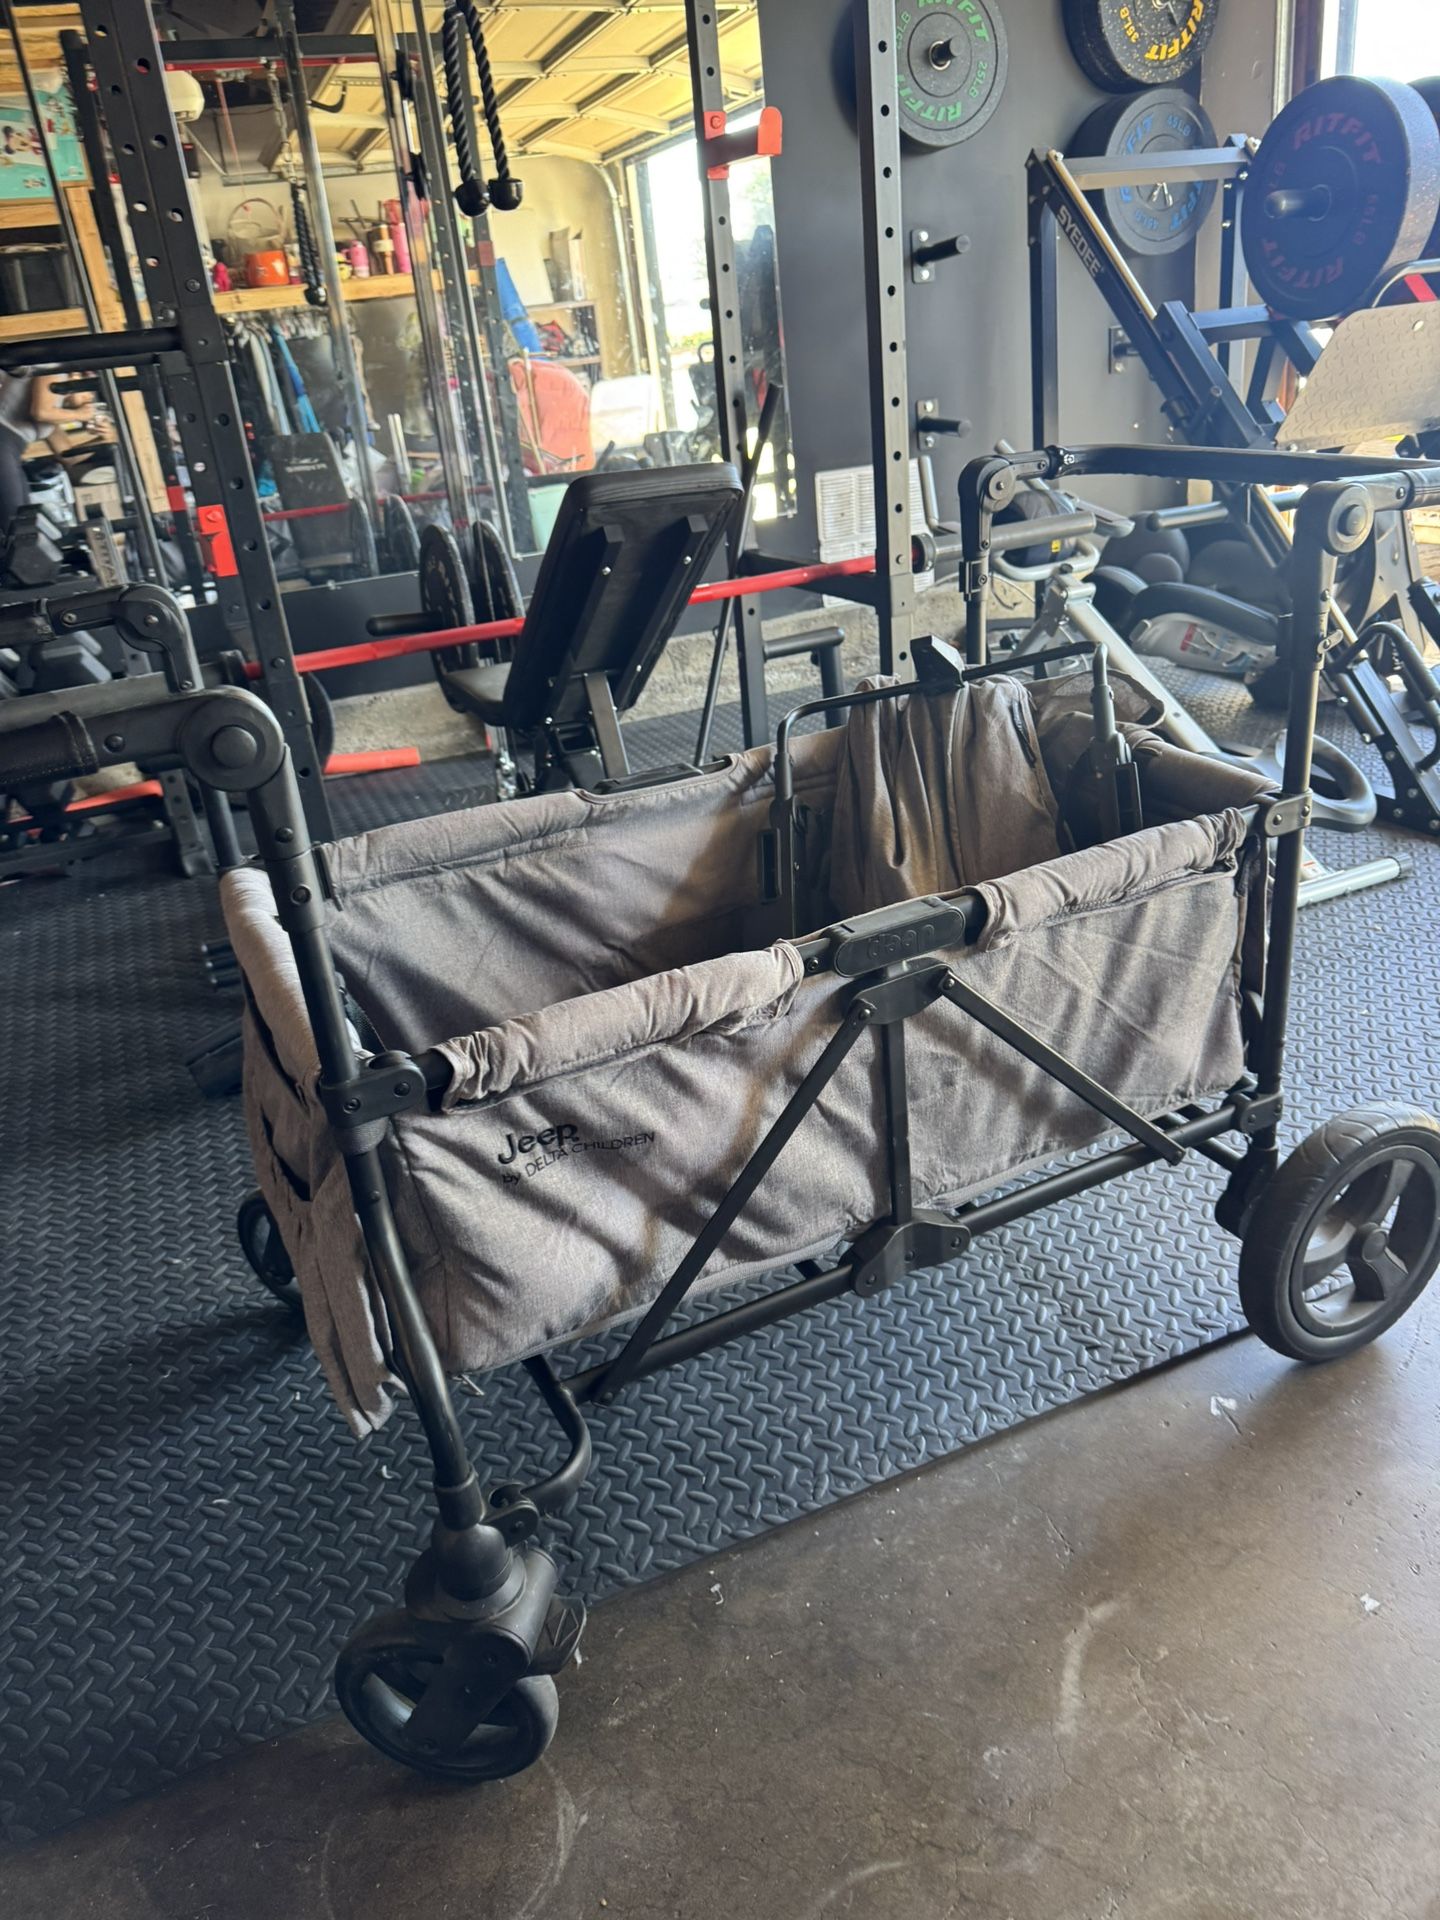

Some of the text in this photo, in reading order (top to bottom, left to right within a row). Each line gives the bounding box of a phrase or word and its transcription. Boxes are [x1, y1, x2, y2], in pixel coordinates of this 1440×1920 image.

[918, 0, 990, 42] FIT
[1120, 6, 1140, 43] 35LB
[1144, 0, 1204, 60] RITFIT
[968, 61, 988, 98] 25LB
[1294, 111, 1383, 165] RITFIT
[1057, 204, 1102, 277] SYEDEE
[1262, 238, 1344, 289] RITFIT
[497, 1123, 580, 1165] Jeep
[502, 1131, 656, 1186] by DELTA CHILDREN
